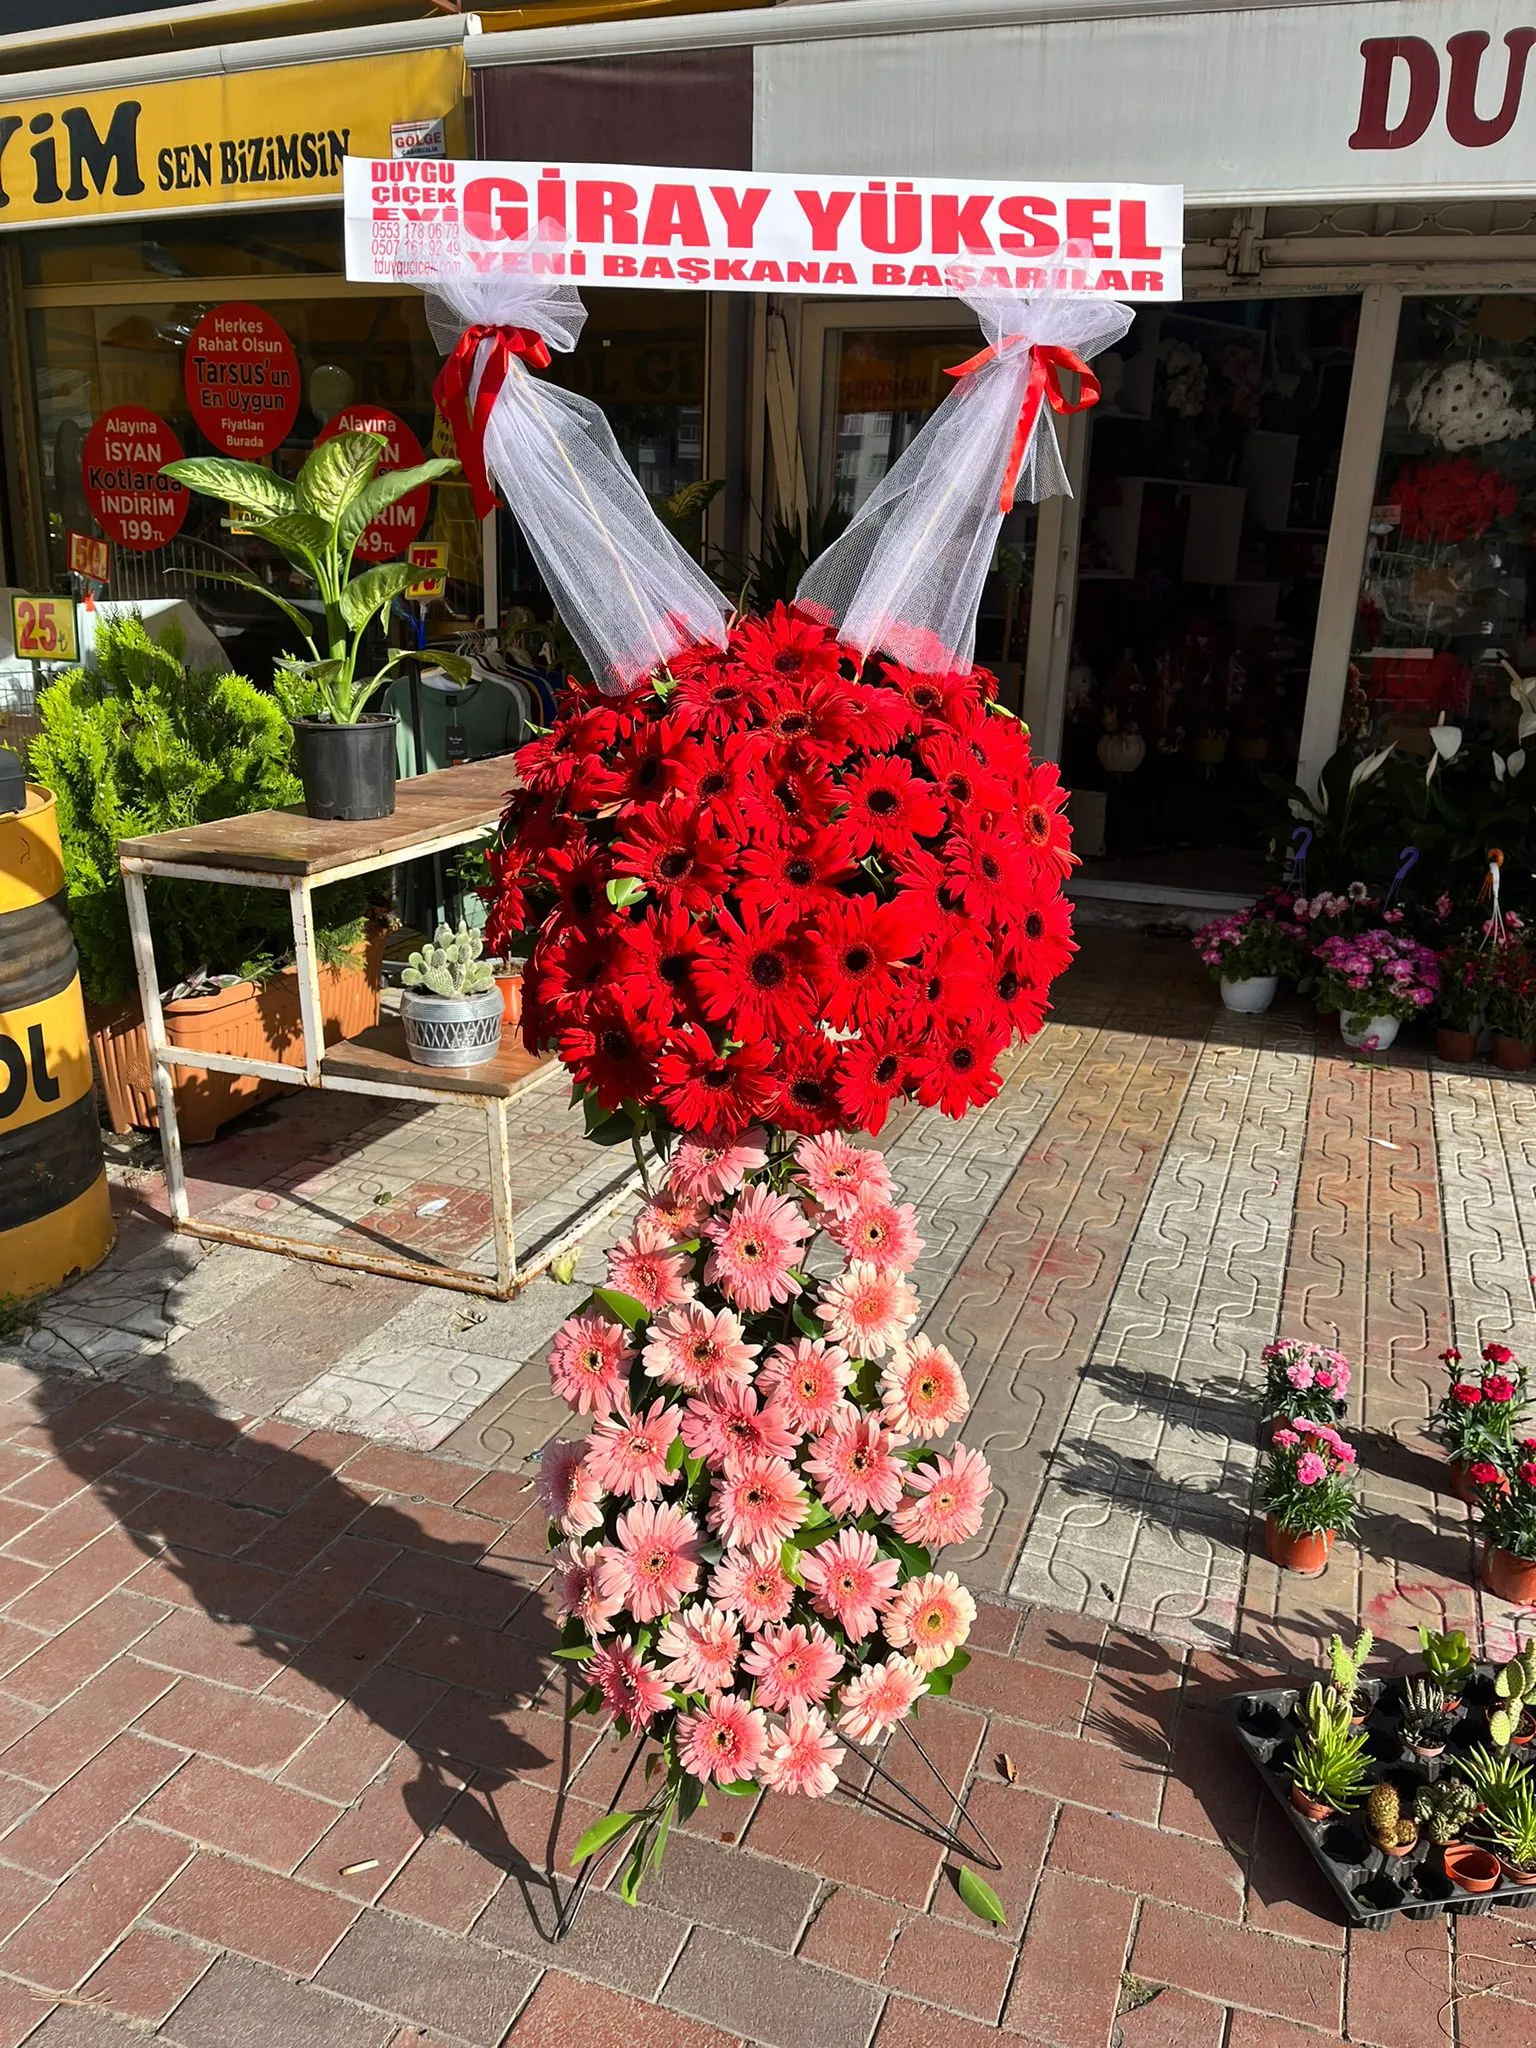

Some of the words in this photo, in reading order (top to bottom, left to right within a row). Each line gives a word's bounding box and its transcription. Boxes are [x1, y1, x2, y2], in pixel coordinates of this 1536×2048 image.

[1348, 26, 1536, 150] DU
[395, 132, 442, 148] GÖLGE
[158, 143, 212, 190] SEN
[371, 161, 455, 184] DUYGU
[371, 183, 456, 205] ÇİÇEK
[373, 205, 458, 221] EVİ
[463, 168, 772, 249] GİRAY
[794, 181, 1162, 260] YÜKSEL
[372, 222, 400, 239] 0553
[404, 222, 425, 240] 178
[428, 222, 443, 240] 06
[371, 239, 400, 256] 0507
[467, 250, 586, 276] YENİ
[603, 255, 858, 285] BAŞKANA
[872, 263, 1164, 291] BAŞARILAR
[214, 318, 263, 333] Herkes
[198, 337, 239, 352] Rahat
[242, 337, 282, 353] Olsun
[201, 389, 223, 408] En
[227, 390, 285, 412] Uygun
[105, 418, 158, 437] Alayına
[221, 418, 265, 432] Fiyatları
[104, 436, 162, 462] İSYAN
[226, 435, 264, 448] Burada
[88, 466, 183, 493] Kotlarda
[100, 490, 175, 516] İNDİRİM
